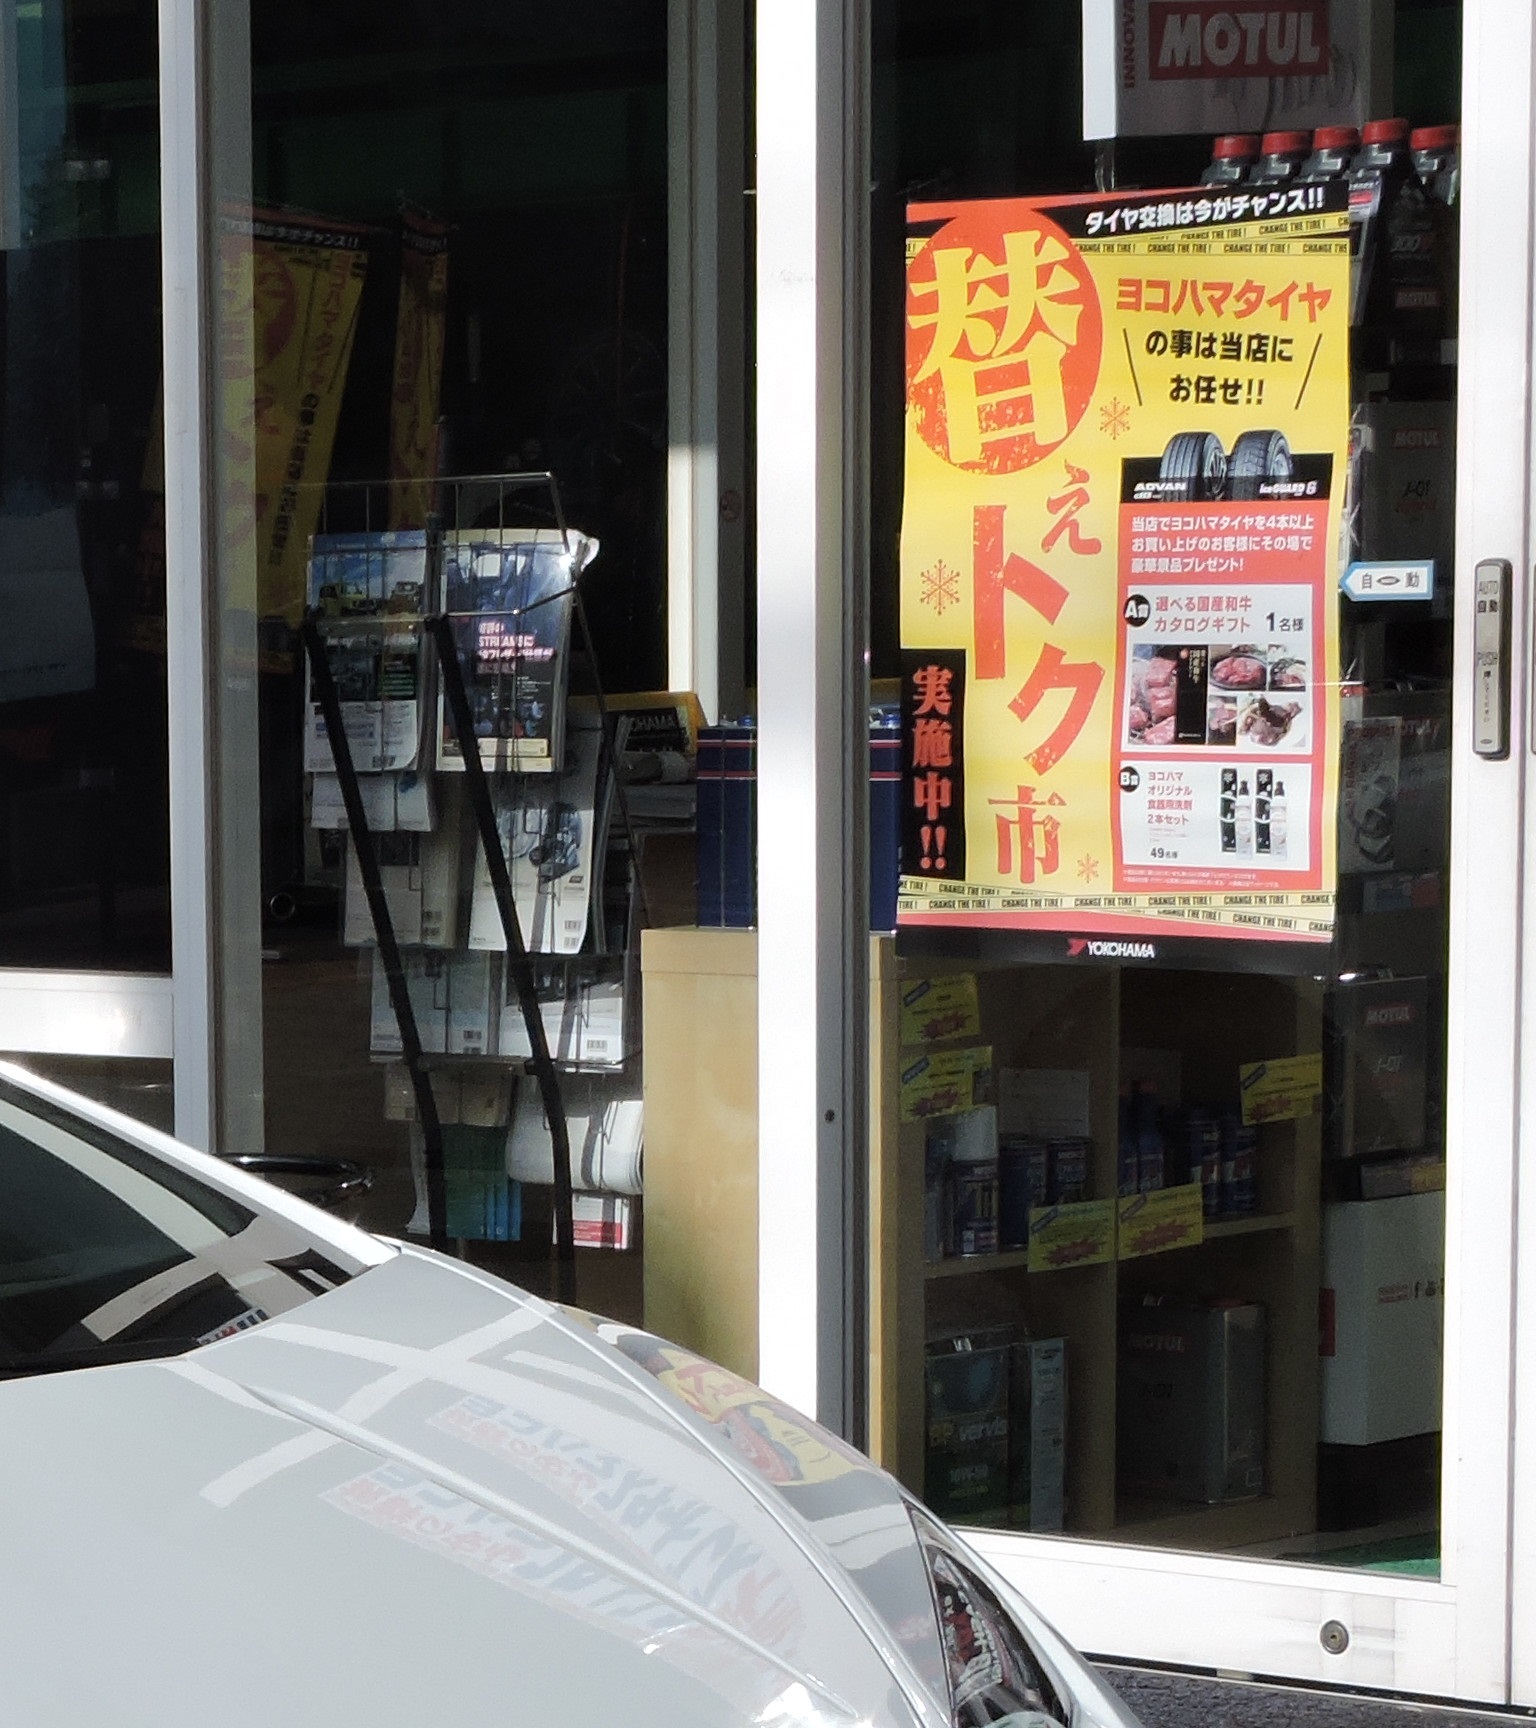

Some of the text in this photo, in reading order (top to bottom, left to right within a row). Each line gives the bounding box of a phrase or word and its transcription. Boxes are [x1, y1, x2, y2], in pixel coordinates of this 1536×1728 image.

[1158, 12, 1321, 68] MOTUL
[1147, 243, 1175, 254] CHANGE
[1177, 243, 1190, 254] THE
[1223, 243, 1253, 254] CHANGE
[1255, 243, 1268, 254] THE
[1302, 243, 1332, 254] CHANGE
[1115, 277, 1333, 323] ヨコハマタイヤ
[1145, 328, 1294, 363] の事は当店に
[1168, 373, 1265, 405] お任せ!!
[1133, 481, 1187, 492] ADVAN
[1154, 617, 1251, 633] カタログギフト
[911, 664, 955, 871] 実施中!!
[1147, 771, 1184, 782] ヨコハマ
[929, 899, 956, 911] CHANGE
[957, 899, 970, 910] THE
[1001, 898, 1028, 909] CHANGE
[1030, 898, 1042, 909] THE
[1074, 897, 1102, 908] CHANGE
[1103, 897, 1116, 908] THE
[1148, 896, 1176, 907] CHANGE
[1177, 896, 1191, 907] THE
[1224, 894, 1252, 906] CHANGE
[1254, 894, 1267, 905] THE
[1301, 894, 1330, 905] CHANGE
[1087, 941, 1156, 959] YOKOHAMA
